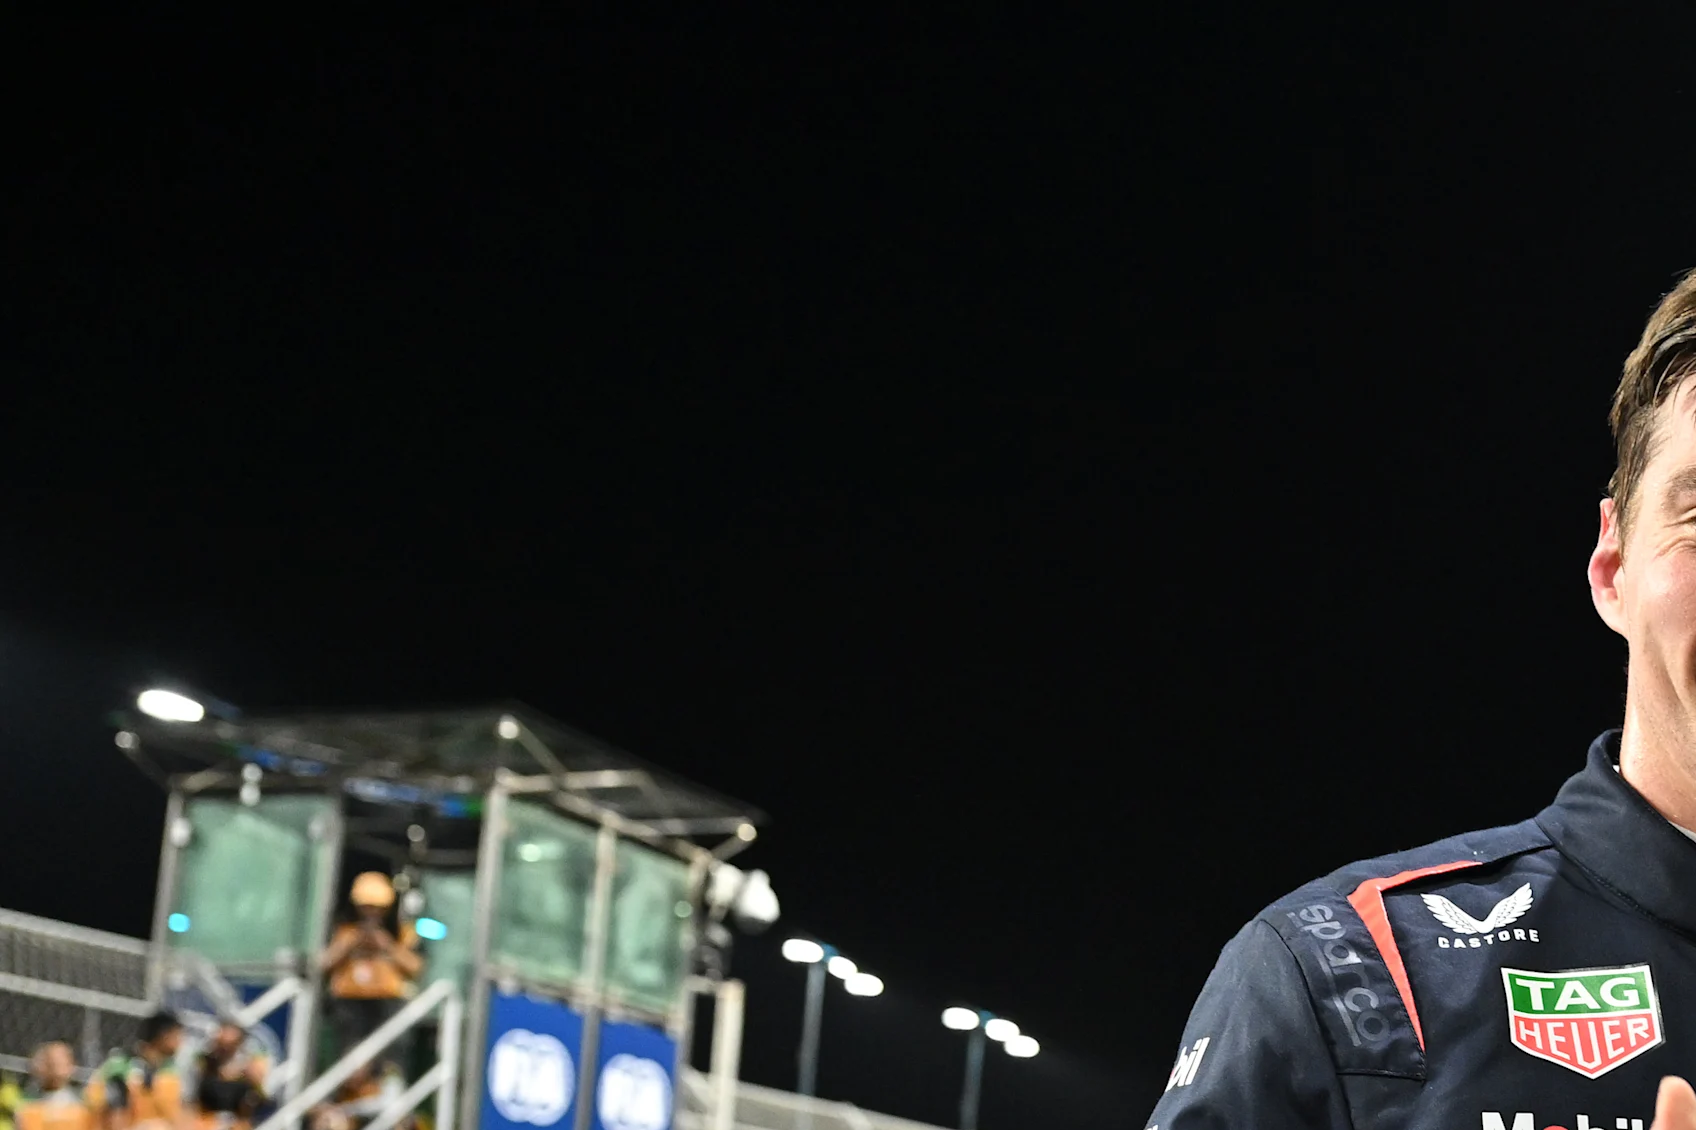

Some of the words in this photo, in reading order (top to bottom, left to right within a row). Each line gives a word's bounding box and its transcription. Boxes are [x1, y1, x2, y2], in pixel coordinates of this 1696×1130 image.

[1437, 927, 1541, 949] CASTORE
[1300, 903, 1391, 1042] sparco
[1515, 976, 1642, 1012] TAG
[1518, 1016, 1651, 1070] HEUER
